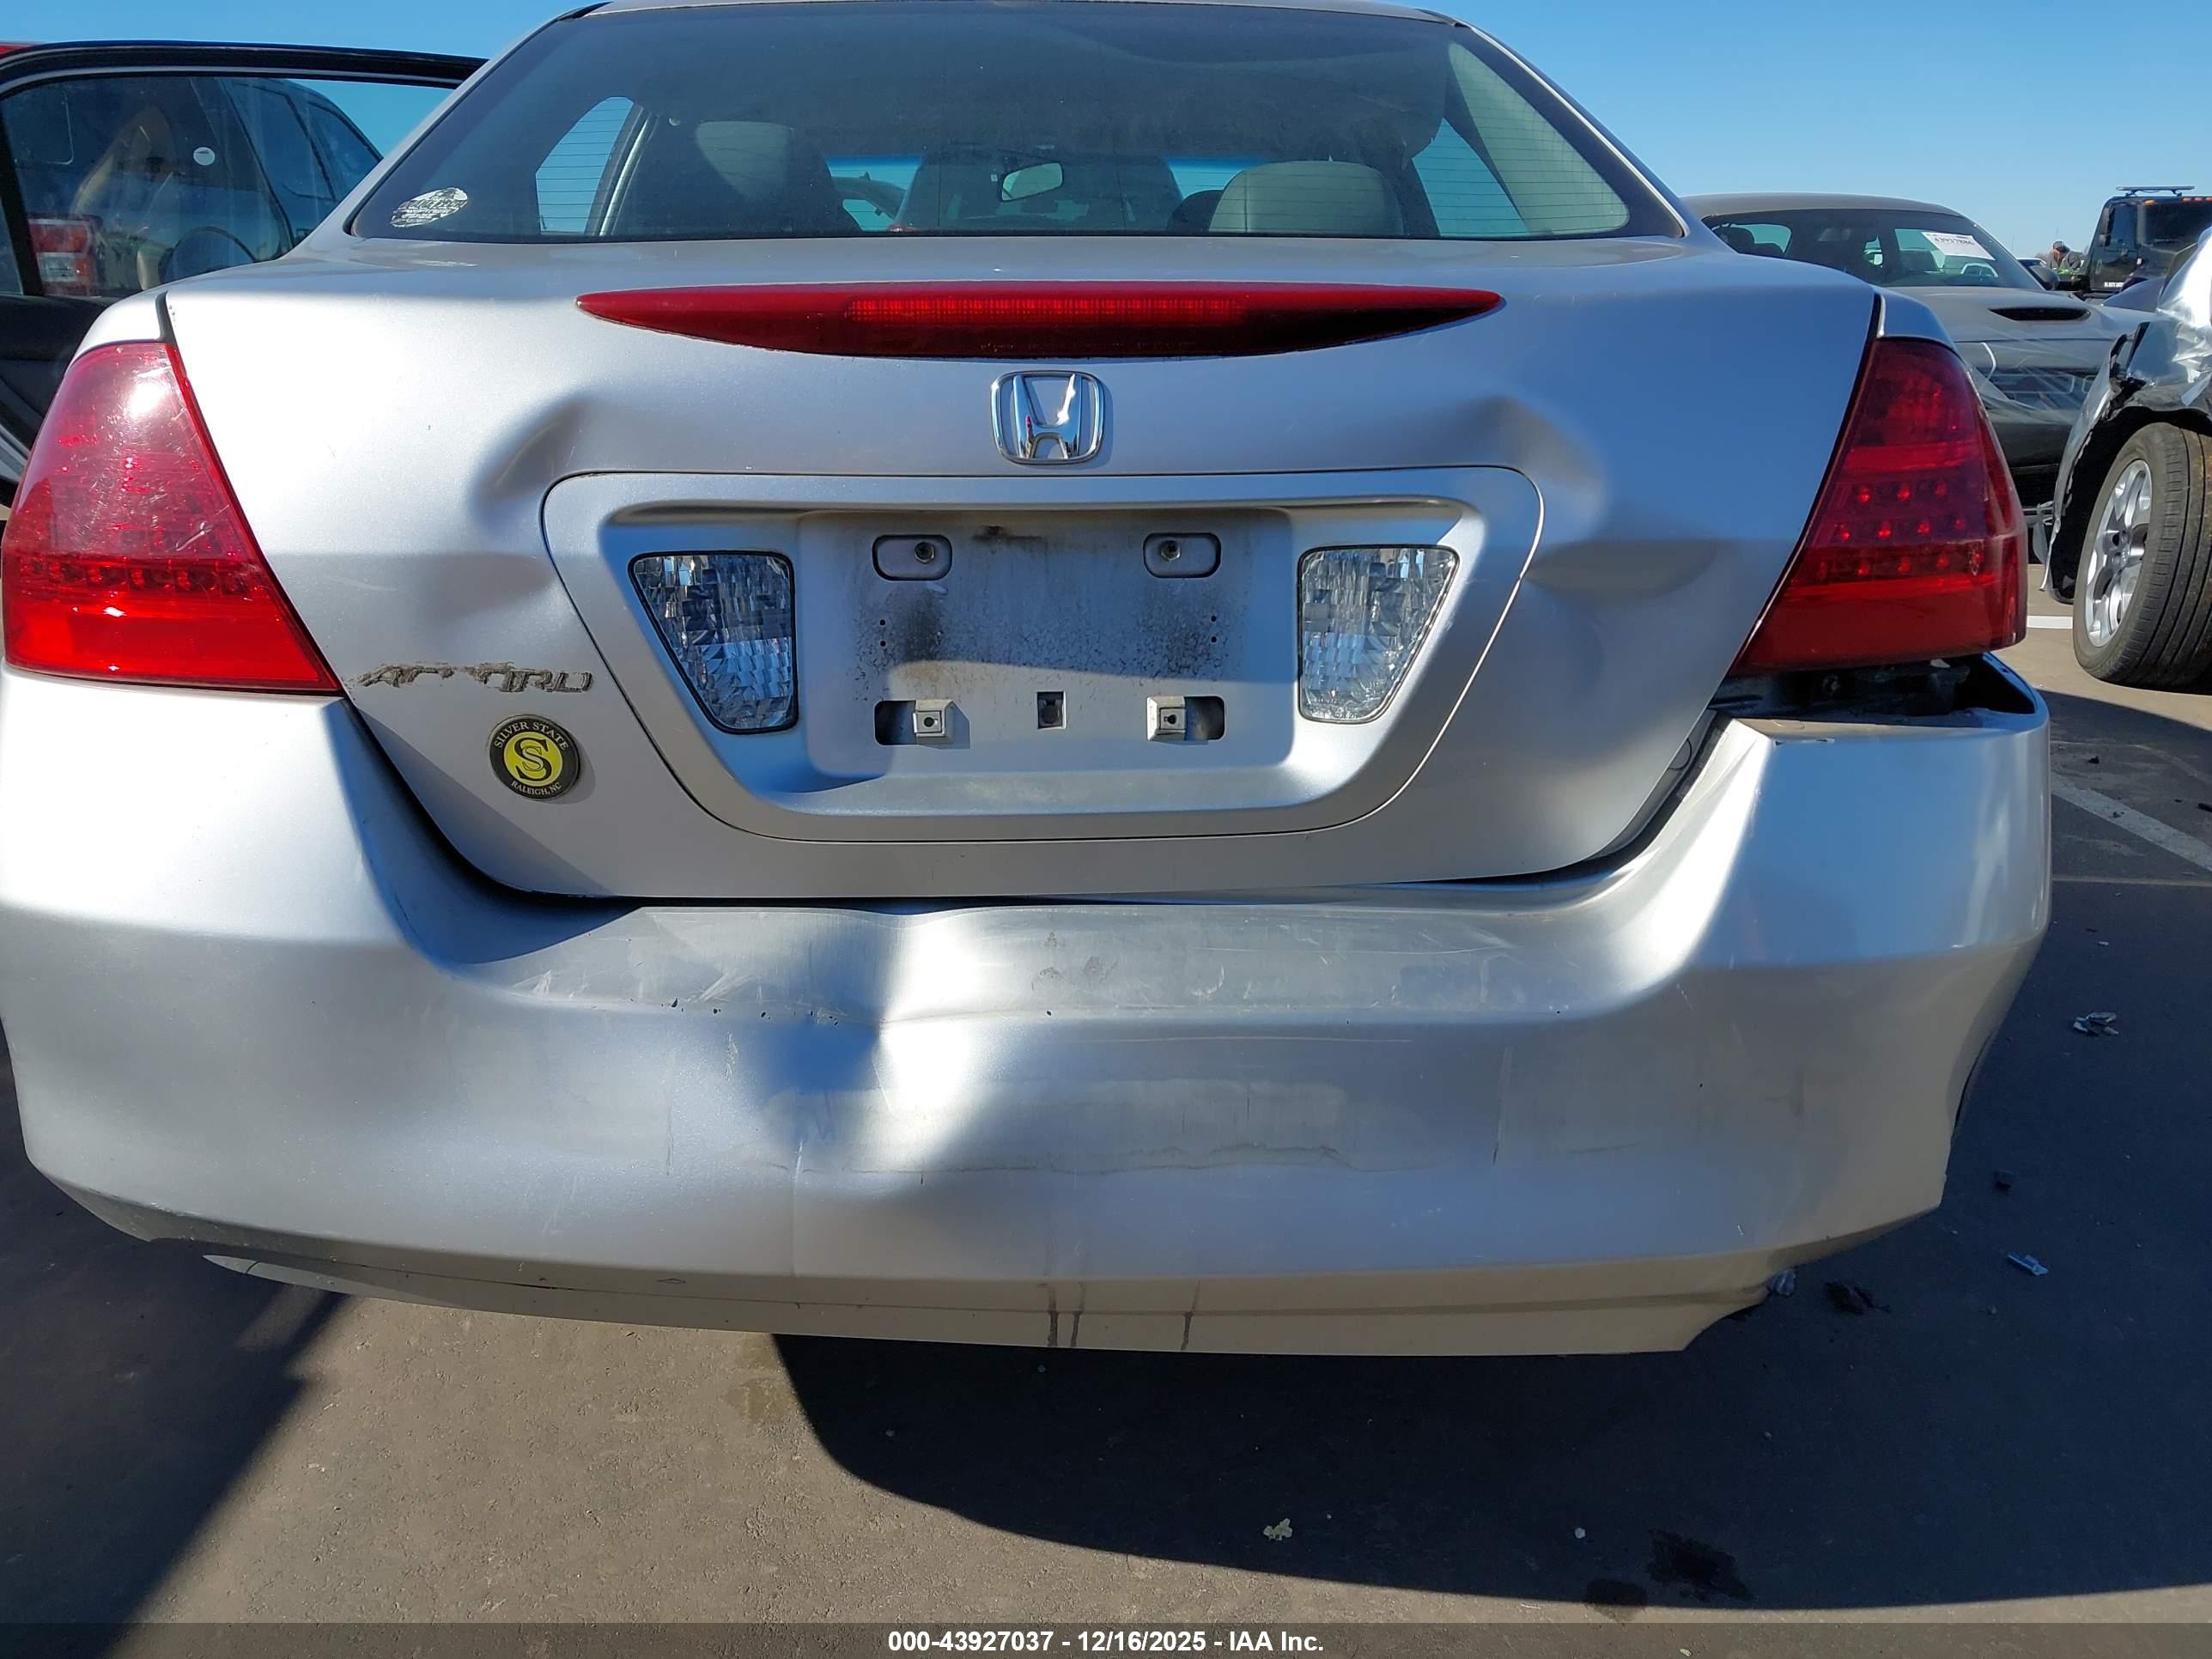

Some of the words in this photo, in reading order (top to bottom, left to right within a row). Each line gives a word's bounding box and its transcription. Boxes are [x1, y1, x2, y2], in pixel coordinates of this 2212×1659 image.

[494, 721, 529, 748] SILVER
[532, 721, 569, 750] STATE
[511, 781, 550, 795] RALEIGH,
[549, 781, 562, 793] NC
